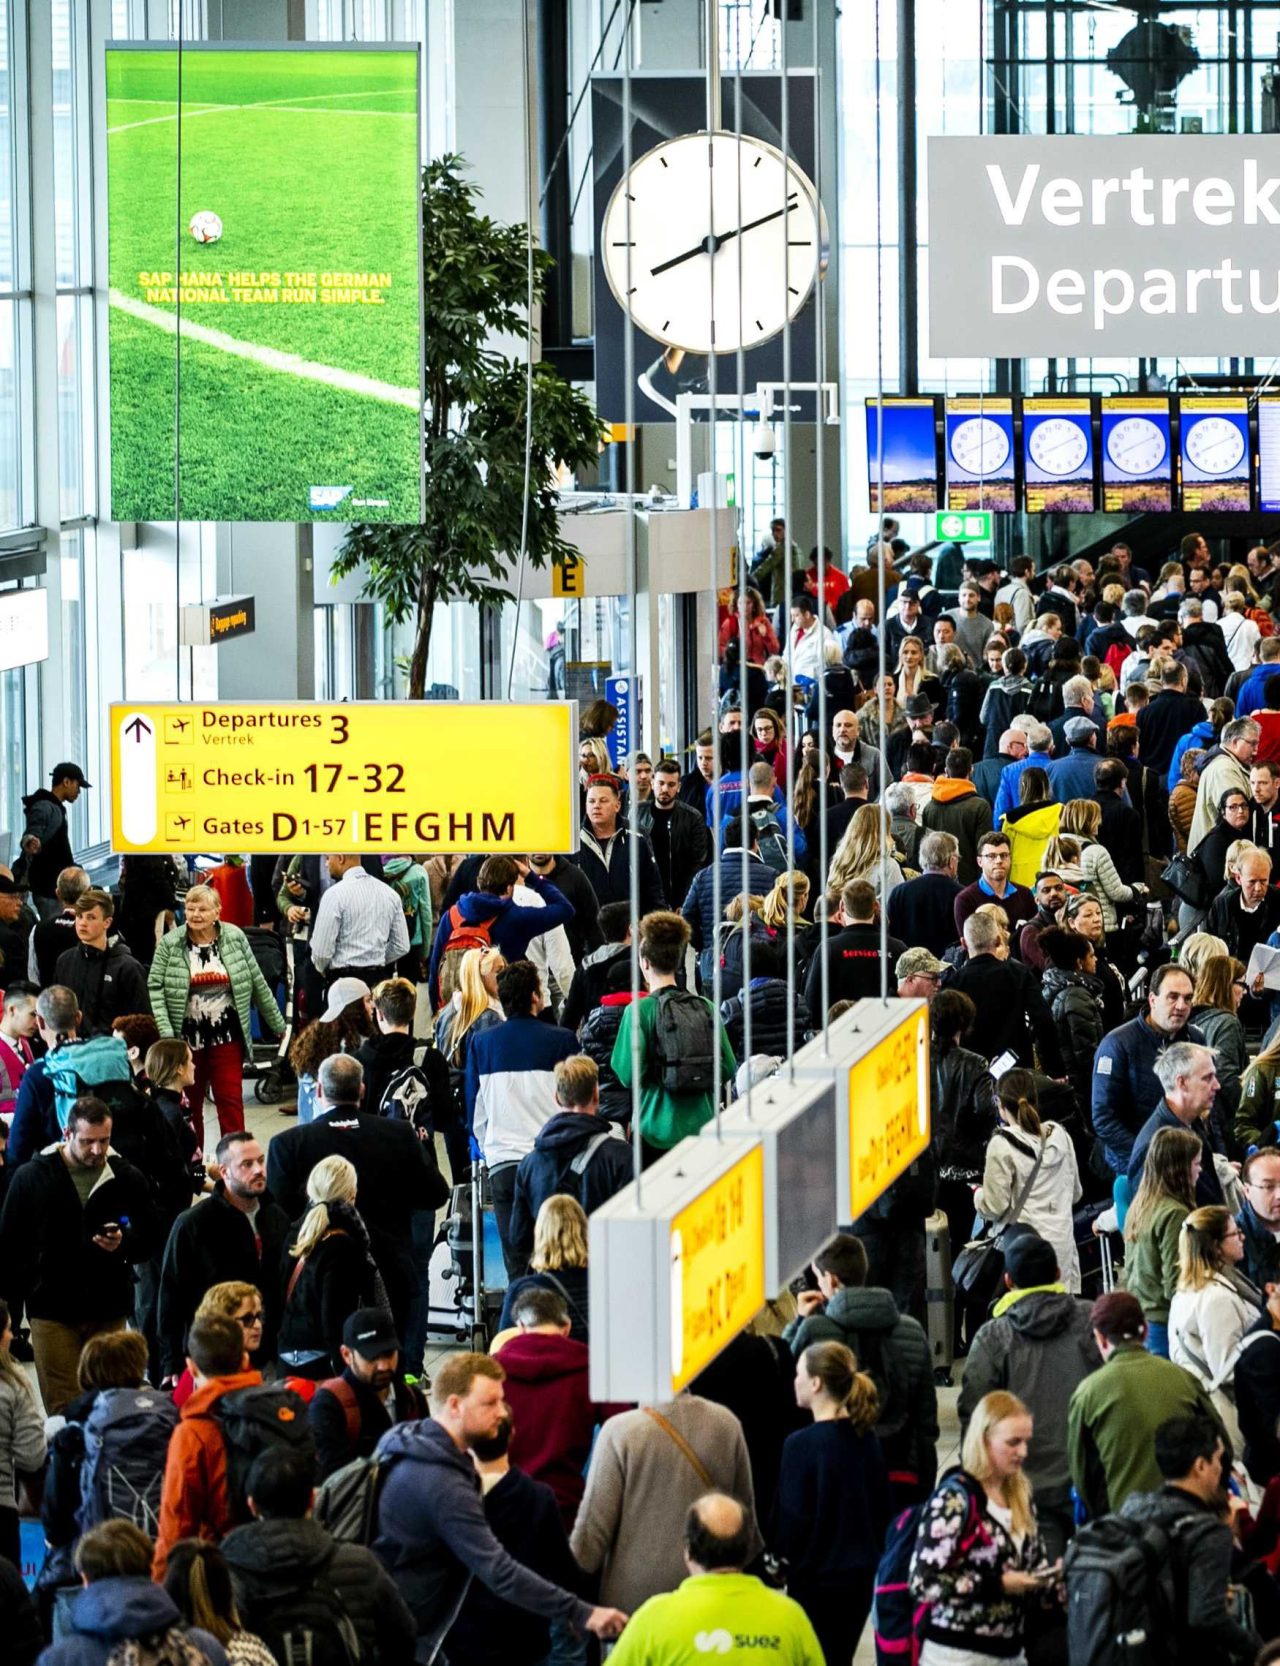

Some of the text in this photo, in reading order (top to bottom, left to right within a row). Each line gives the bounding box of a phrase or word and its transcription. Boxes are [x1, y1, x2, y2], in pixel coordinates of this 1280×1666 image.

[139, 271, 392, 287] SAP HANA HELPS THE GERMAN
[147, 288, 229, 303] NATIONAL
[231, 288, 279, 303] TEAM
[282, 288, 316, 303] RUN
[562, 564, 576, 592] E
[203, 711, 350, 744] Departures 3
[202, 734, 254, 745] Vertrek
[203, 764, 406, 793] Check-in 17-32
[203, 817, 264, 834] Gates
[734, 1633, 781, 1650] suez
